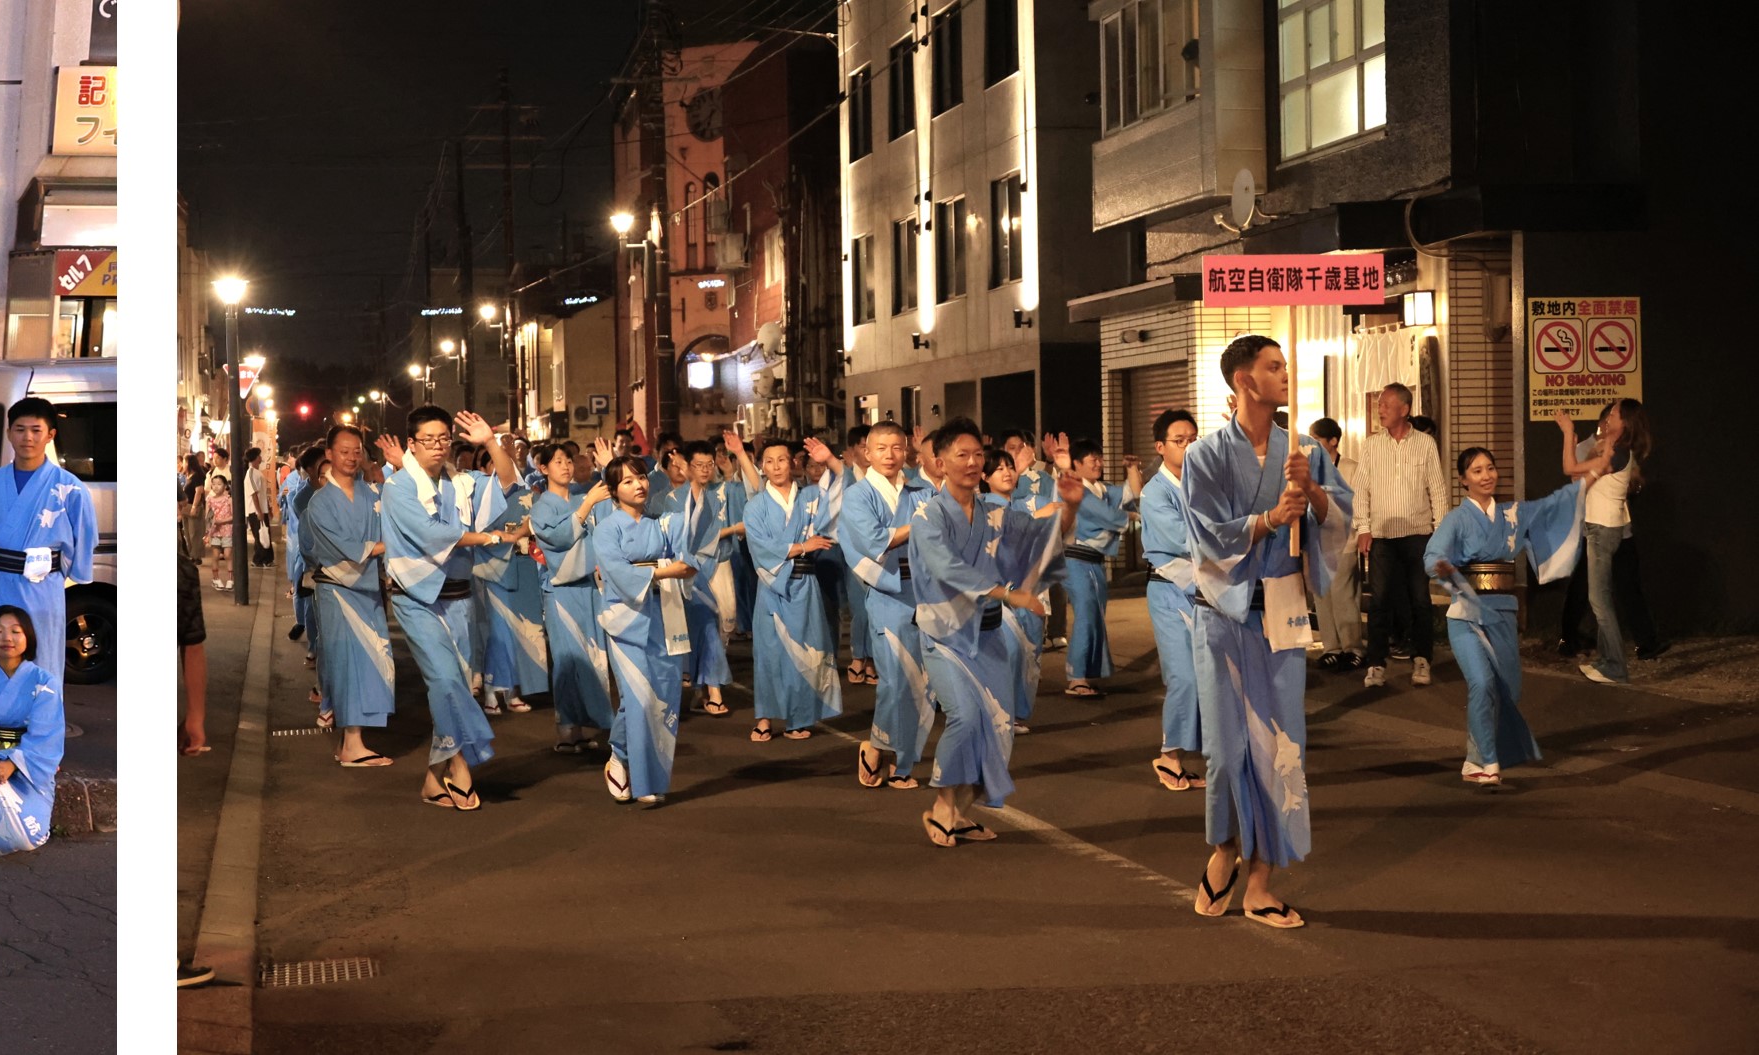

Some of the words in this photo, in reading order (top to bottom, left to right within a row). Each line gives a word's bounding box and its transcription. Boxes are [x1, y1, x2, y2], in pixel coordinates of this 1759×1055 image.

[58, 254, 92, 291] セルフ
[1208, 266, 1380, 293] 航空自衛隊千歳基地
[1531, 300, 1638, 316] 敷地内全面禁煙
[1545, 375, 1564, 387] NO
[1566, 373, 1626, 387] SMOKING
[592, 397, 607, 414] P
